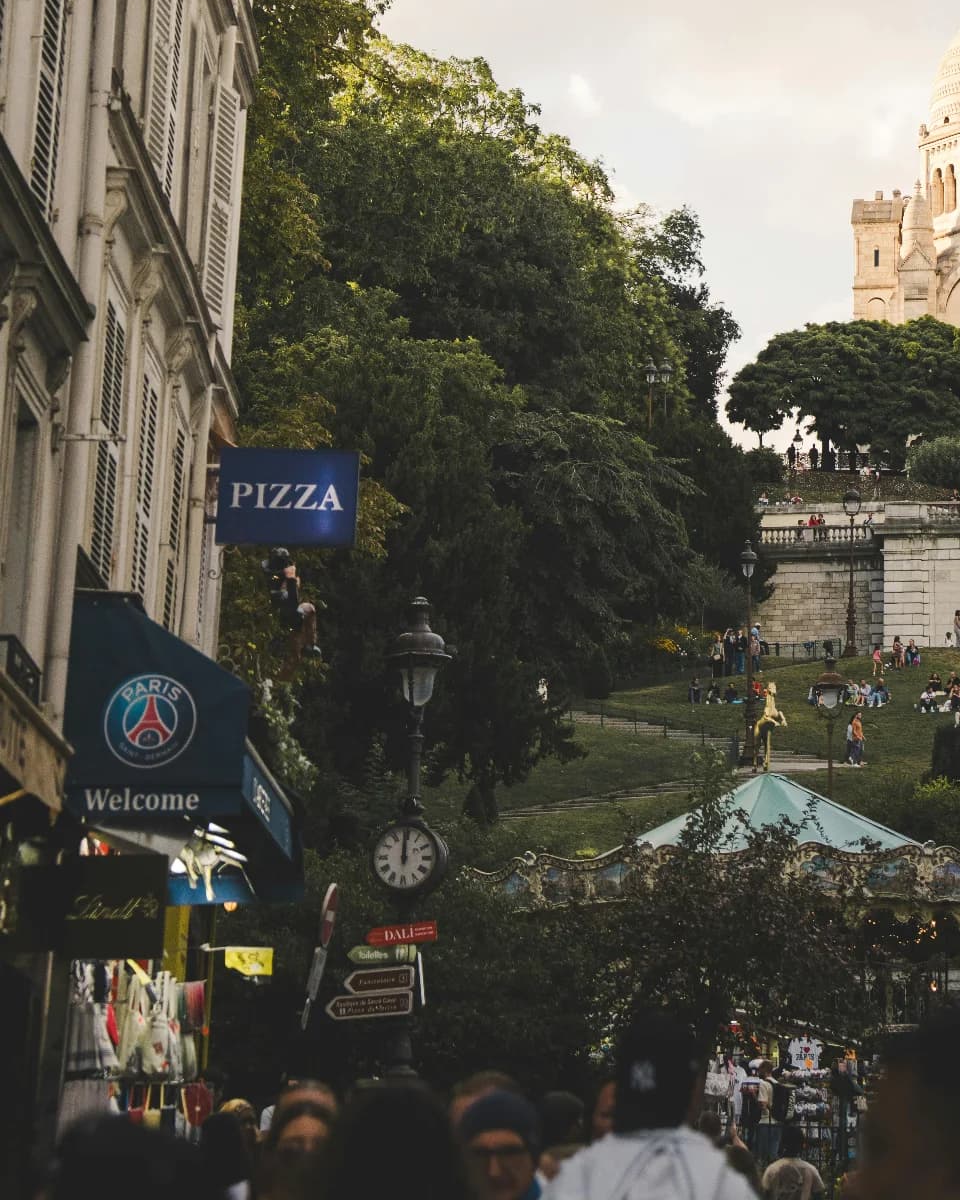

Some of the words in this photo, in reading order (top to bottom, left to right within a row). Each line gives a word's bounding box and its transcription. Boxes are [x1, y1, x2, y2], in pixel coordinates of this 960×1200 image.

[229, 482, 344, 511] PIZZA
[121, 678, 182, 702] PARIS
[84, 787, 200, 811] Welcome
